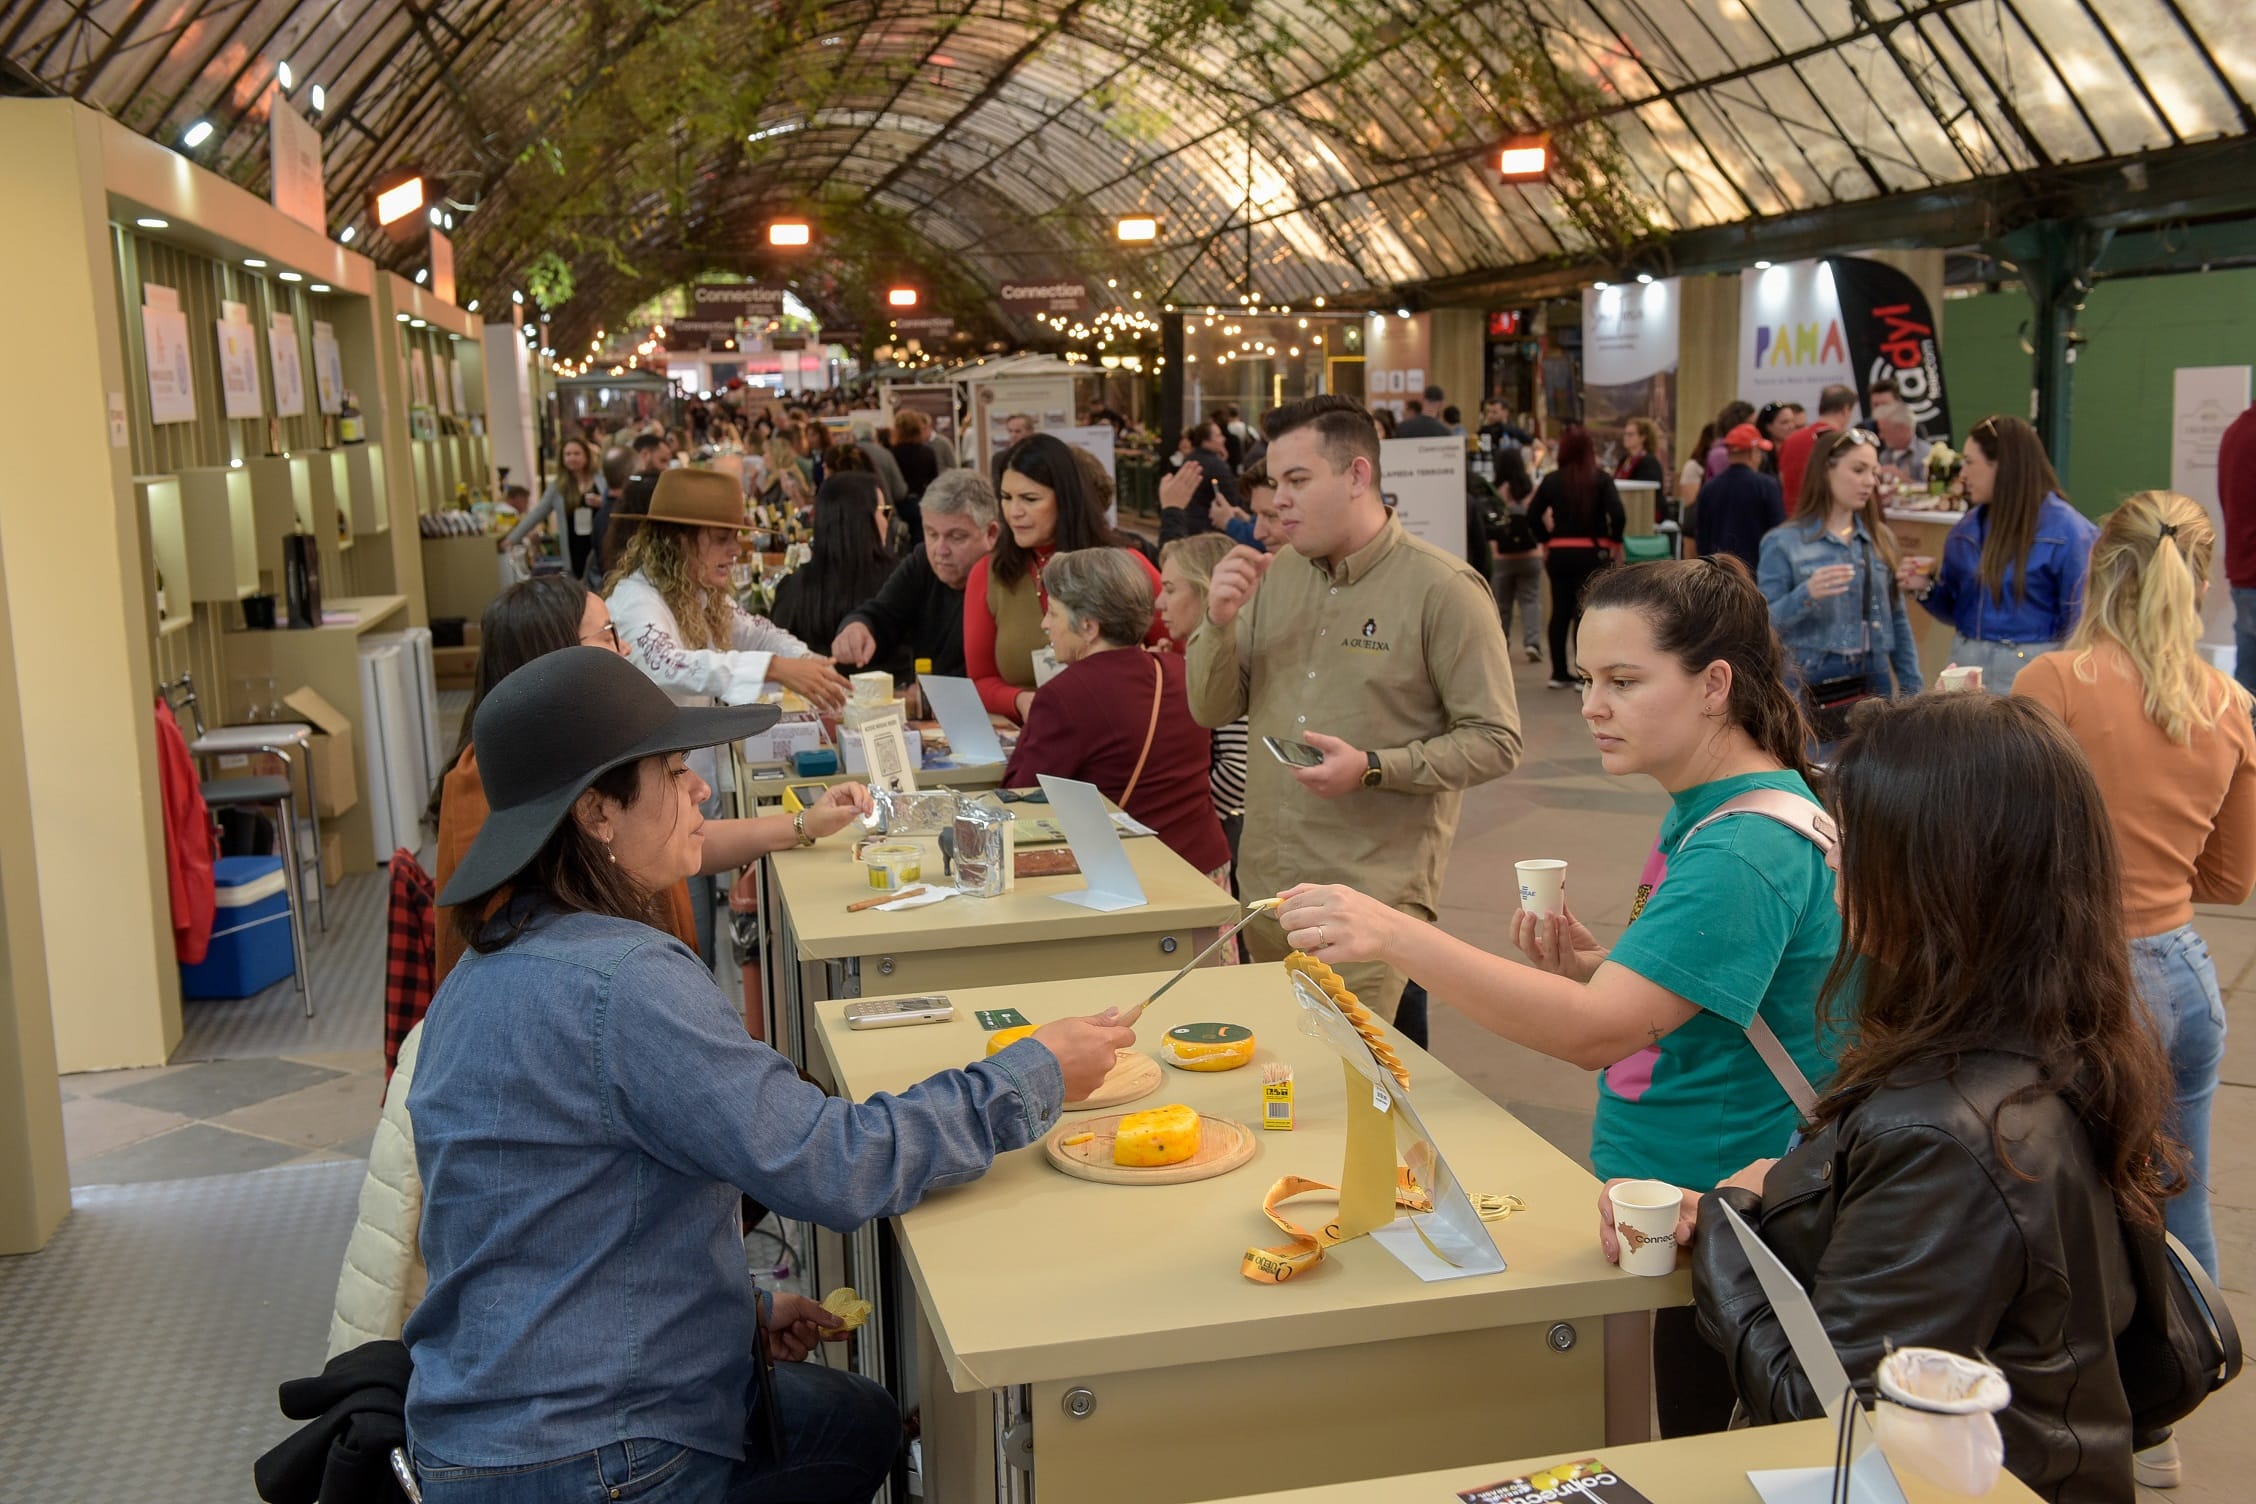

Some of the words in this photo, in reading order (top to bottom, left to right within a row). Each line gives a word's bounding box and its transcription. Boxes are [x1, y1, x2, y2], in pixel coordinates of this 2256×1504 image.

[695, 287, 782, 303] Connection
[1001, 283, 1085, 299] Connection
[1755, 319, 1845, 368] PAMA
